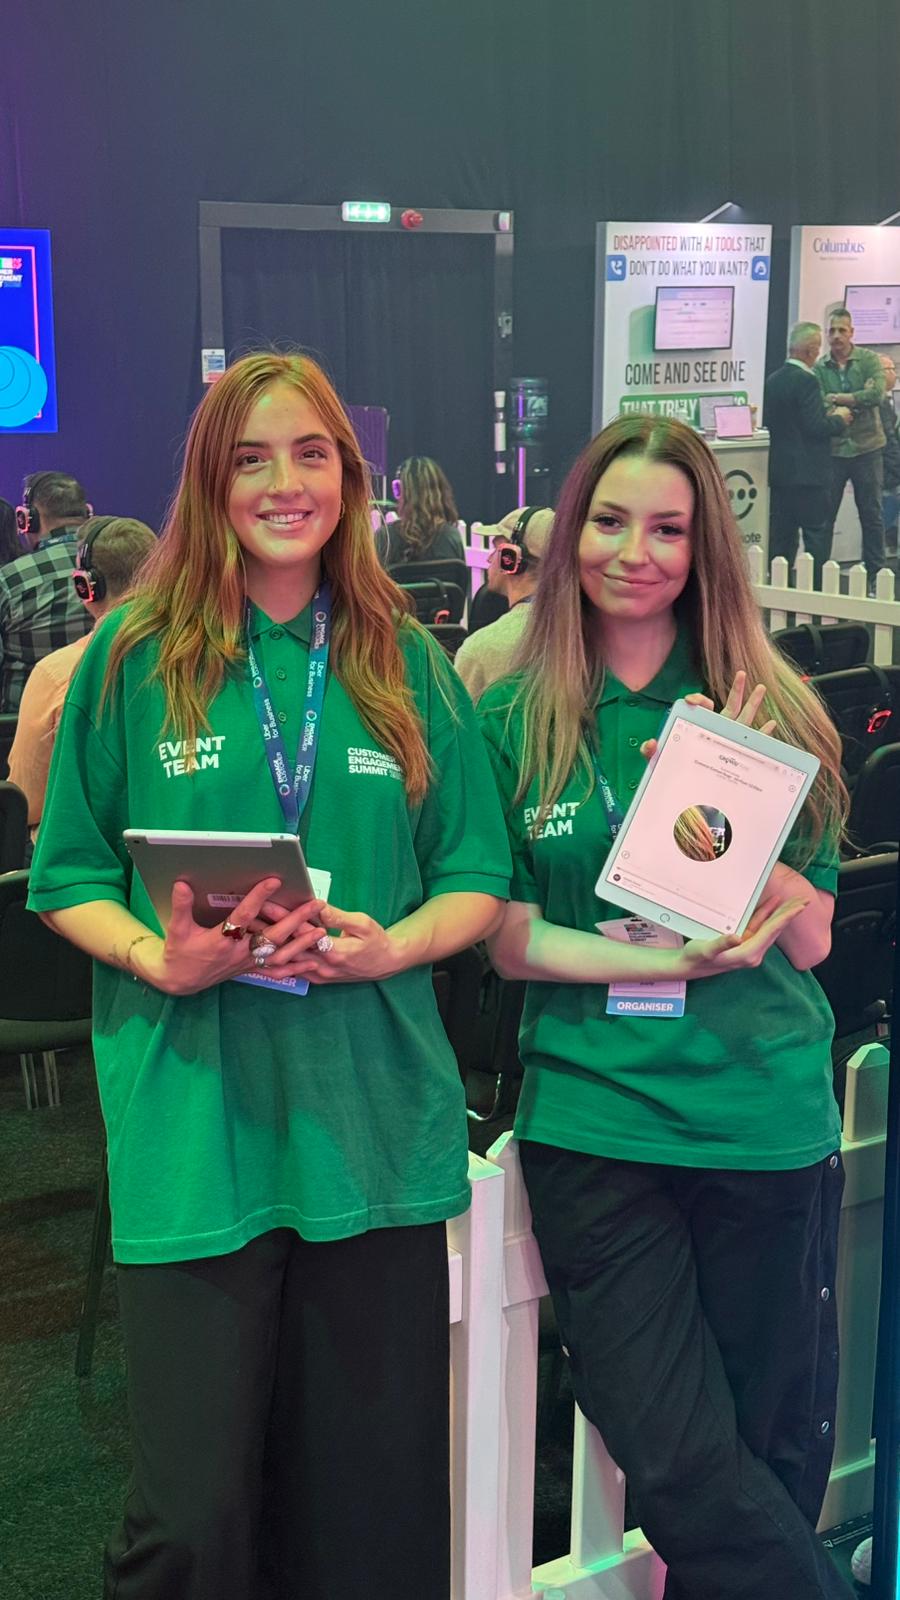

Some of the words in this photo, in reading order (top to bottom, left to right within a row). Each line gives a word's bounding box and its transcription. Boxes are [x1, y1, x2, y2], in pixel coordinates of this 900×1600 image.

[613, 235, 677, 251] DISAPPOINTED
[679, 236, 702, 251] WITH
[704, 236, 713, 252] AI
[715, 236, 742, 252] TOOLS
[744, 237, 766, 251] THAT
[813, 237, 865, 253] Columbus
[629, 260, 656, 276] DON'T
[658, 261, 671, 276] DO
[672, 261, 697, 276] WHAT
[699, 261, 716, 276] YOU
[718, 261, 749, 277] WANT?
[625, 363, 661, 386] COME
[664, 362, 690, 384] AND
[693, 361, 717, 383] SEE
[720, 361, 746, 381] ONE
[309, 661, 317, 670] for
[306, 671, 316, 697] Business
[264, 698, 276, 728] Business
[262, 724, 272, 740] Uber
[158, 735, 226, 761] EVENT
[163, 753, 219, 779] TEAM
[296, 765, 304, 774] for
[302, 765, 311, 782] Uber
[348, 764, 388, 776] SUMMIT
[616, 1001, 674, 1012] ORGANISER
